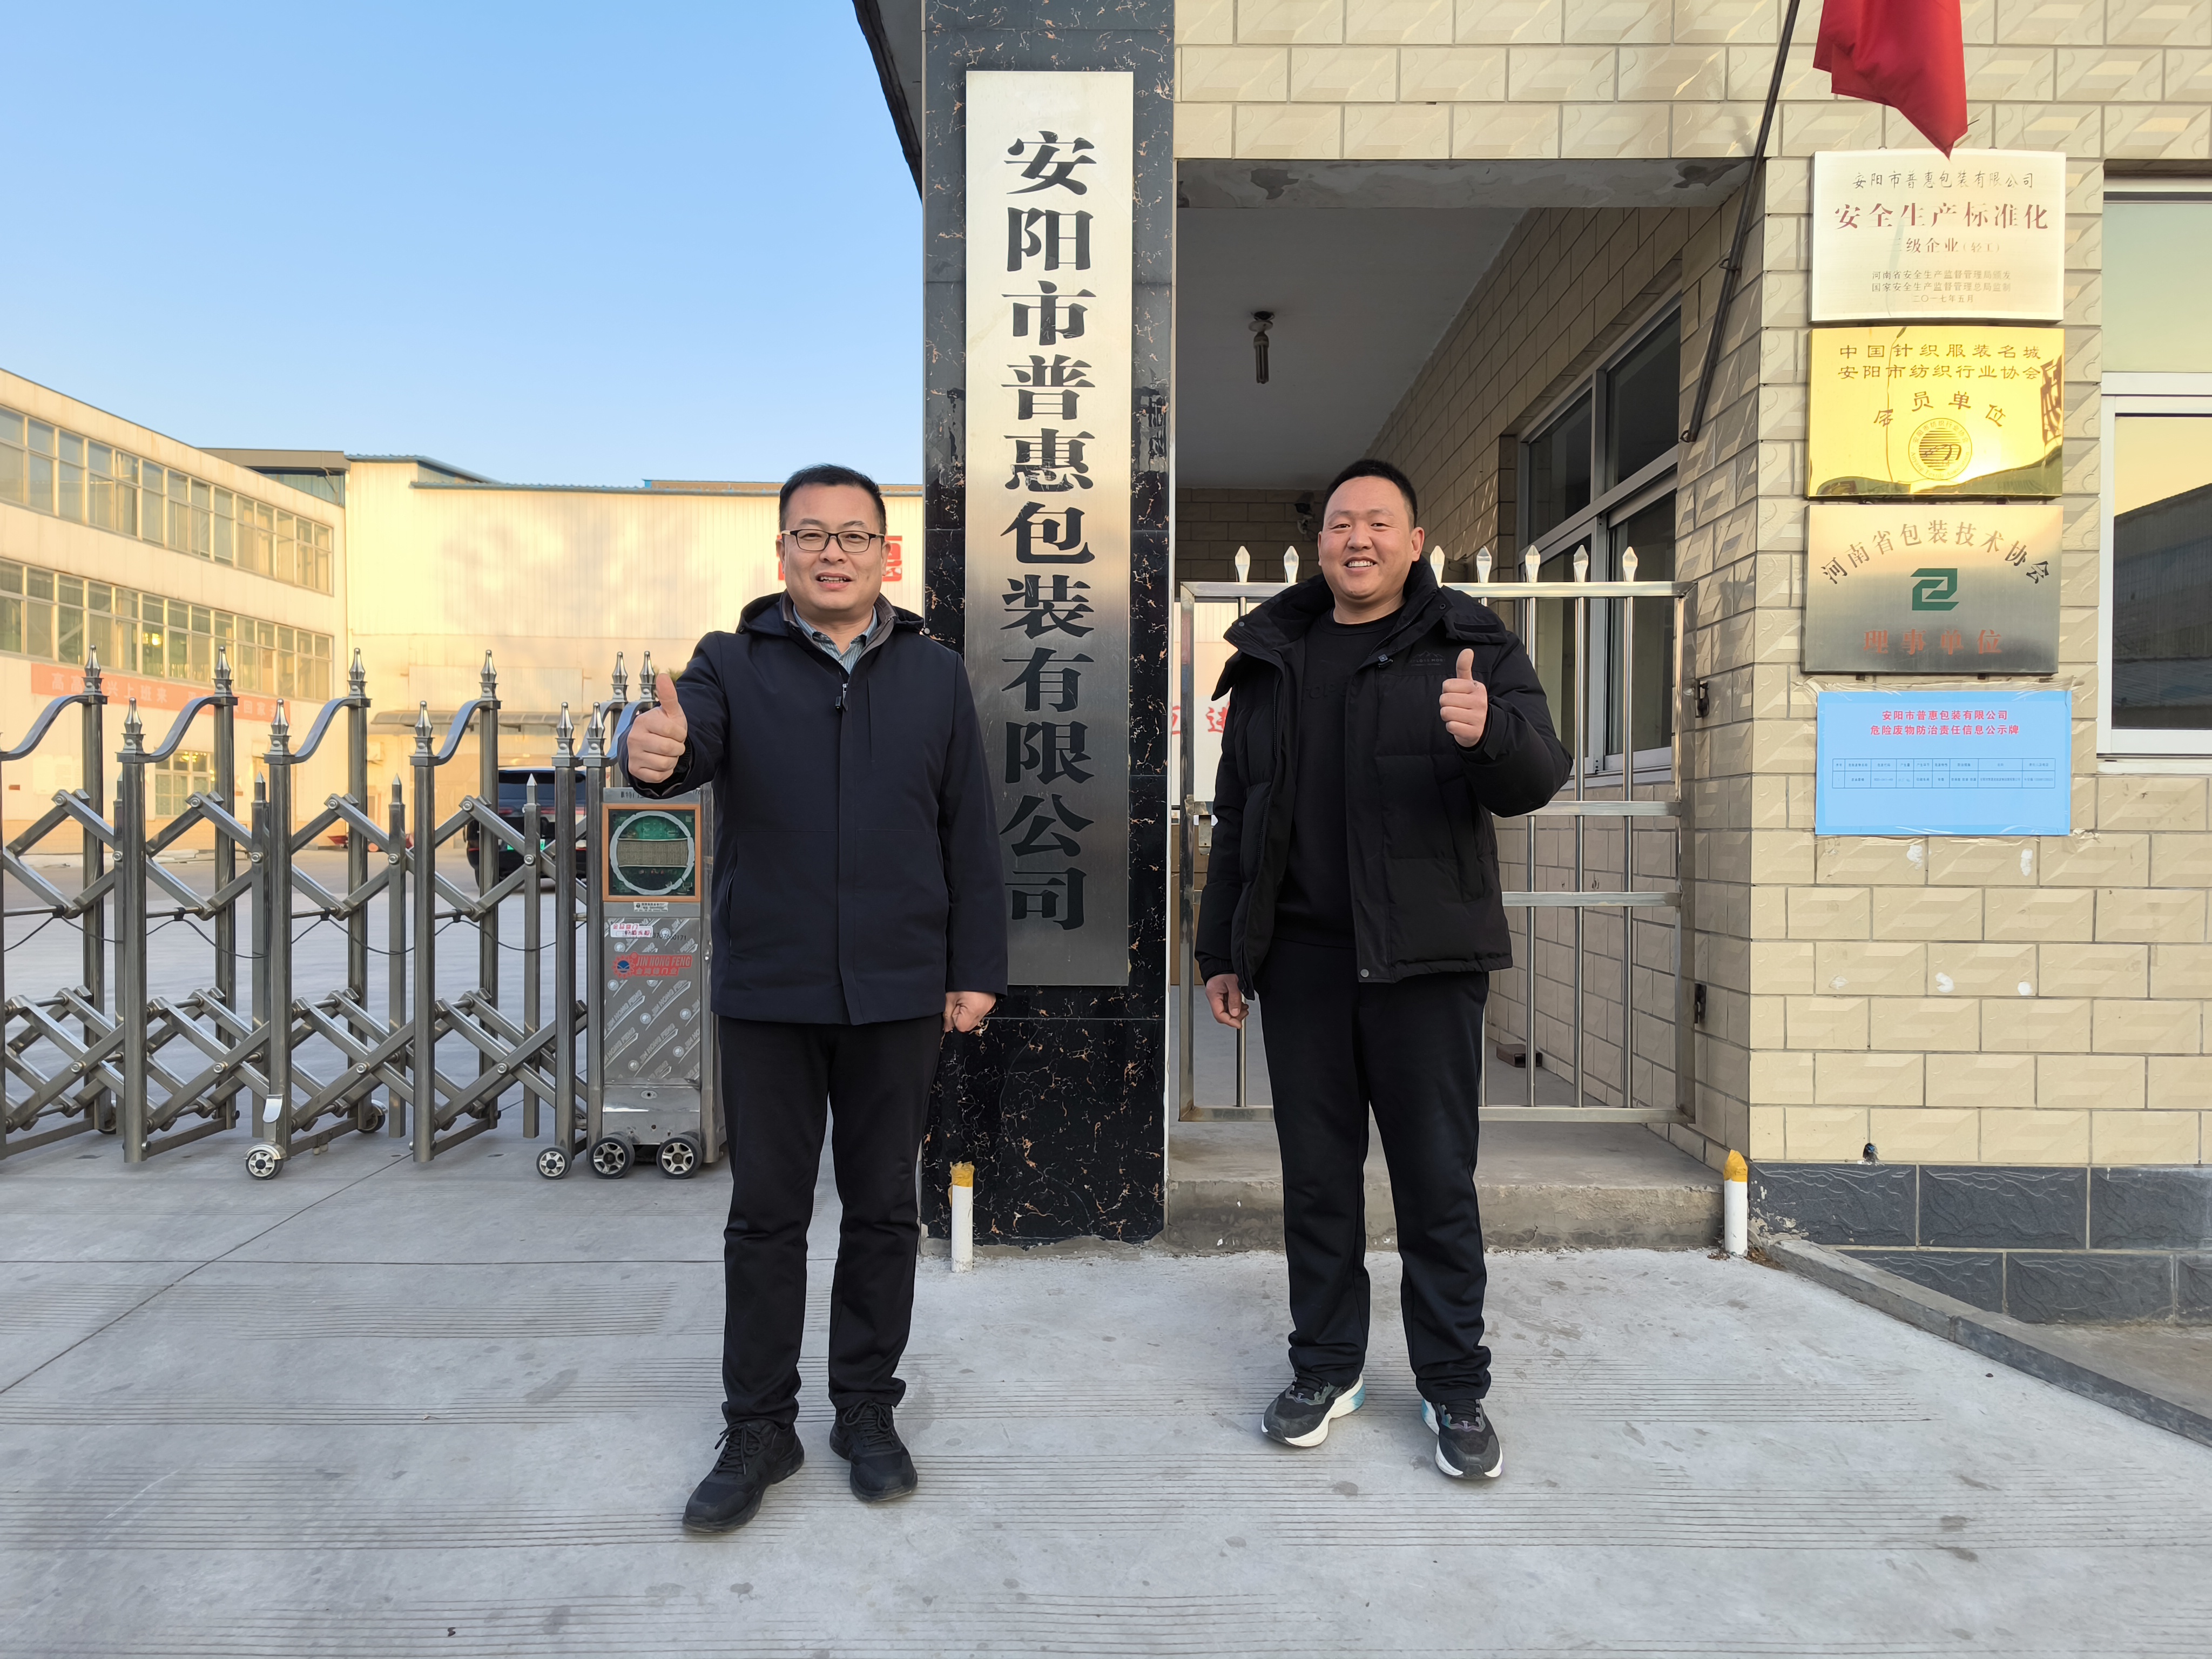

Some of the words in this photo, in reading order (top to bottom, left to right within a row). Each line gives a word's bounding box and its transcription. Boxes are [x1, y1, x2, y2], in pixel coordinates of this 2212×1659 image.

[1852, 169, 2034, 189] 安阳市普惠包装有限公司
[1835, 201, 2048, 230] 安全生产标准化
[1872, 270, 2011, 280] 河南省安全生产监督管理局颁发
[1872, 282, 2011, 292] 国家安全生产监督管理总局监制
[1839, 343, 2041, 360] 中国针织服装名城
[1838, 364, 2041, 380] 安阳市纺织行业协会
[1873, 390, 2006, 427] 会员单位
[1000, 131, 1098, 930] 安阳市普惠包装有限公司
[1820, 520, 2050, 584] 河南省包装技术协会
[1863, 629, 2002, 655] 理事单位
[51, 672, 167, 704] 高高兴上班来
[1881, 710, 2008, 721] 安阳市普惠包装有限公司
[1870, 725, 2019, 736] 危险废物防治责任信息公示牌
[636, 956, 649, 967] JIN
[649, 956, 670, 967] HONG
[671, 956, 691, 967] FENG
